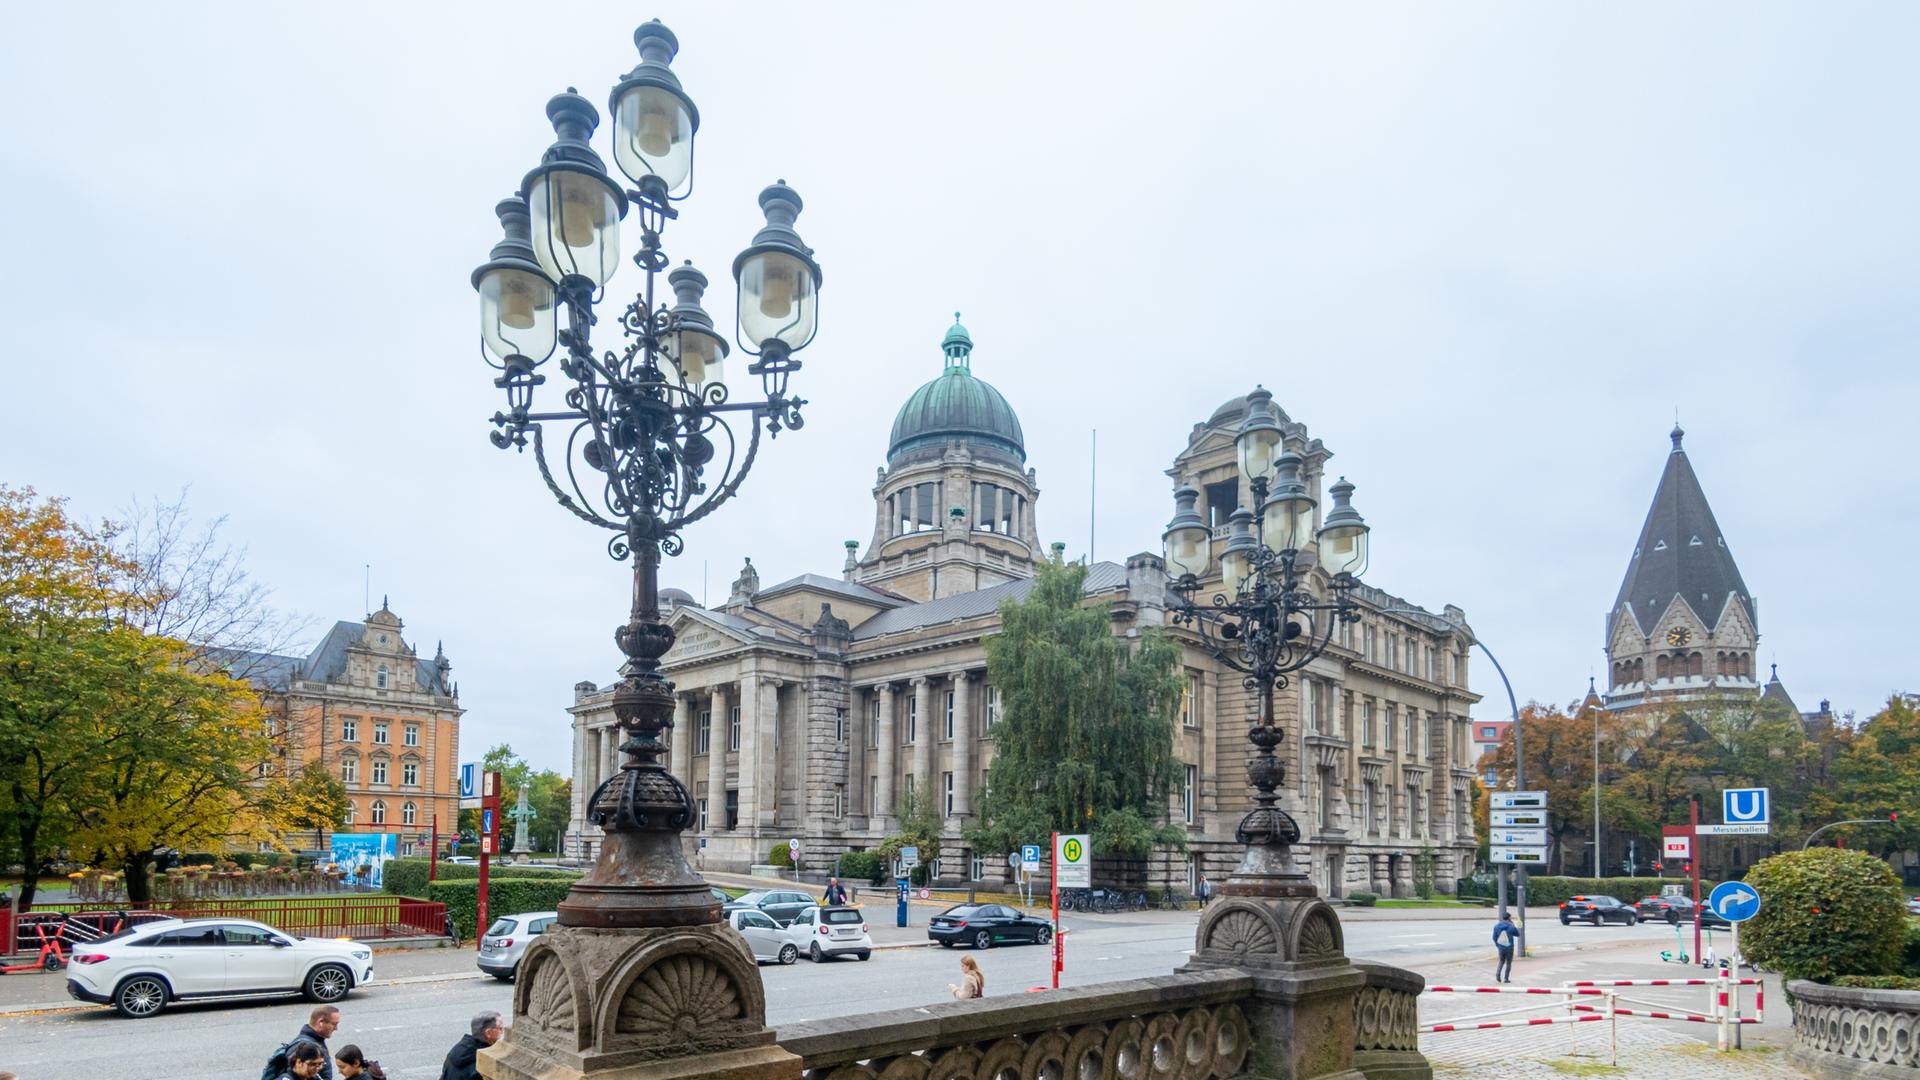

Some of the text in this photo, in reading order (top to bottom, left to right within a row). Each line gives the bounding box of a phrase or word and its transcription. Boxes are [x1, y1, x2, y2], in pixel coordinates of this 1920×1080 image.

[463, 766, 473, 794] U
[1730, 792, 1760, 820] U
[1025, 848, 1035, 860] P
[1069, 844, 1077, 857] H
